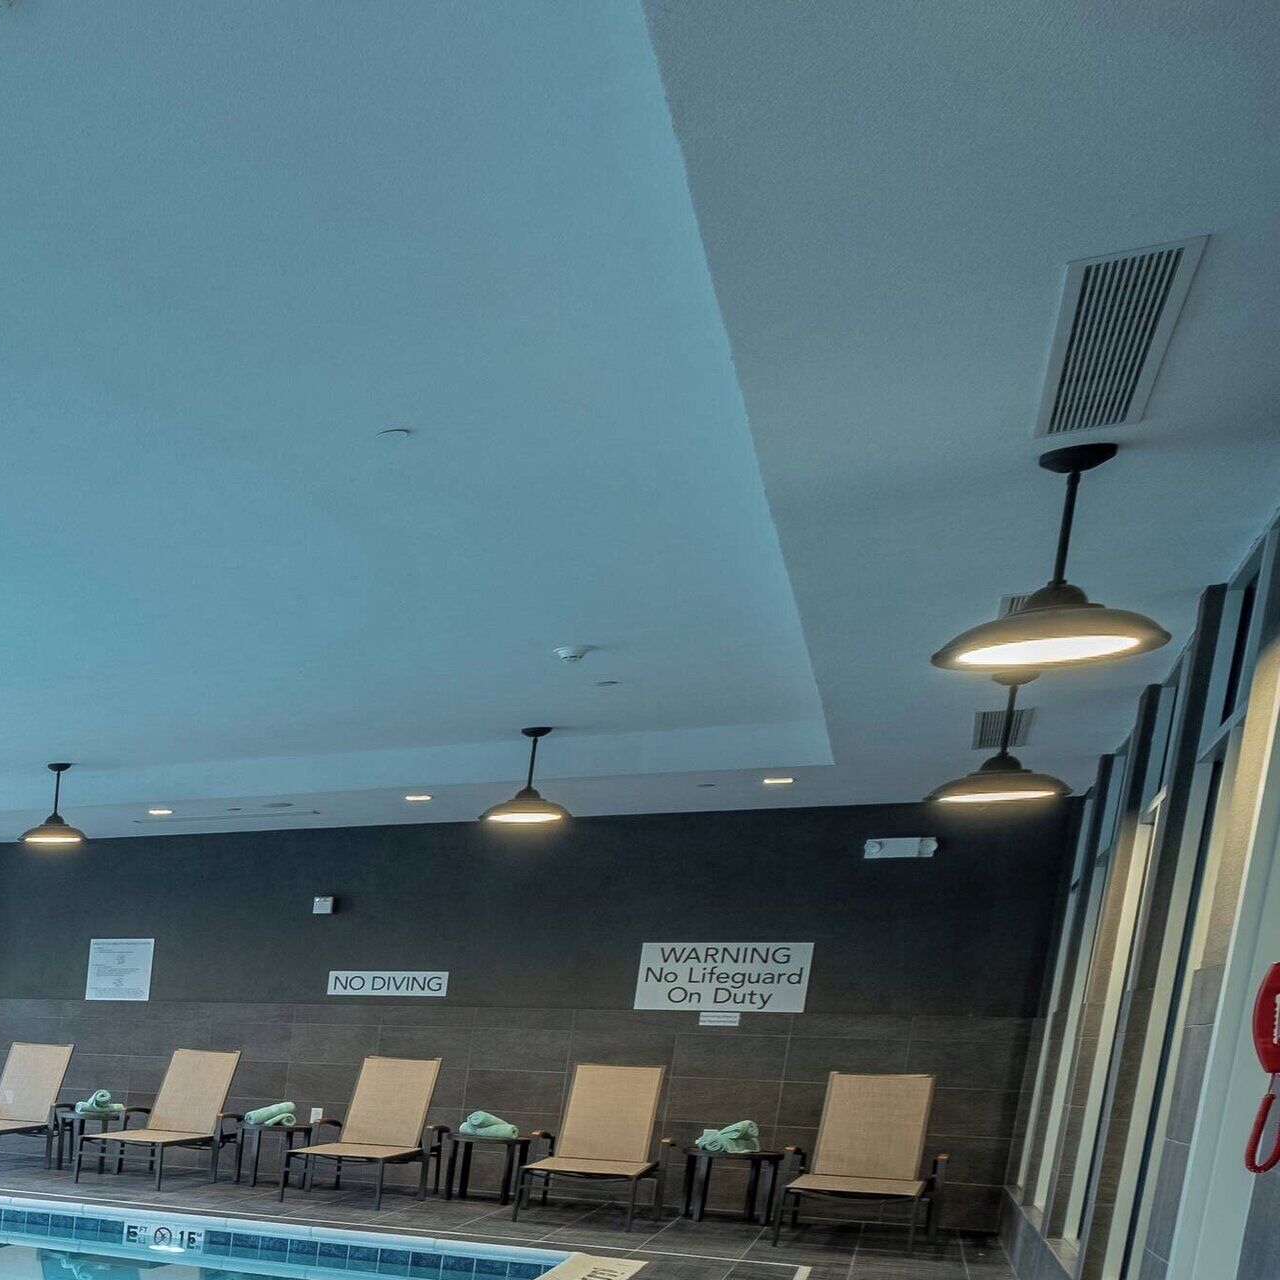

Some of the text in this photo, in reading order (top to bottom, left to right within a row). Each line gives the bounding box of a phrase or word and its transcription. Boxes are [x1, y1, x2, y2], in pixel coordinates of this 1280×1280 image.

[660, 946, 792, 965] WARNING
[333, 976, 442, 992] NO DIVING
[644, 966, 804, 989] No Lifeguard
[667, 986, 774, 1010] On Duty
[126, 1225, 138, 1243] 5
